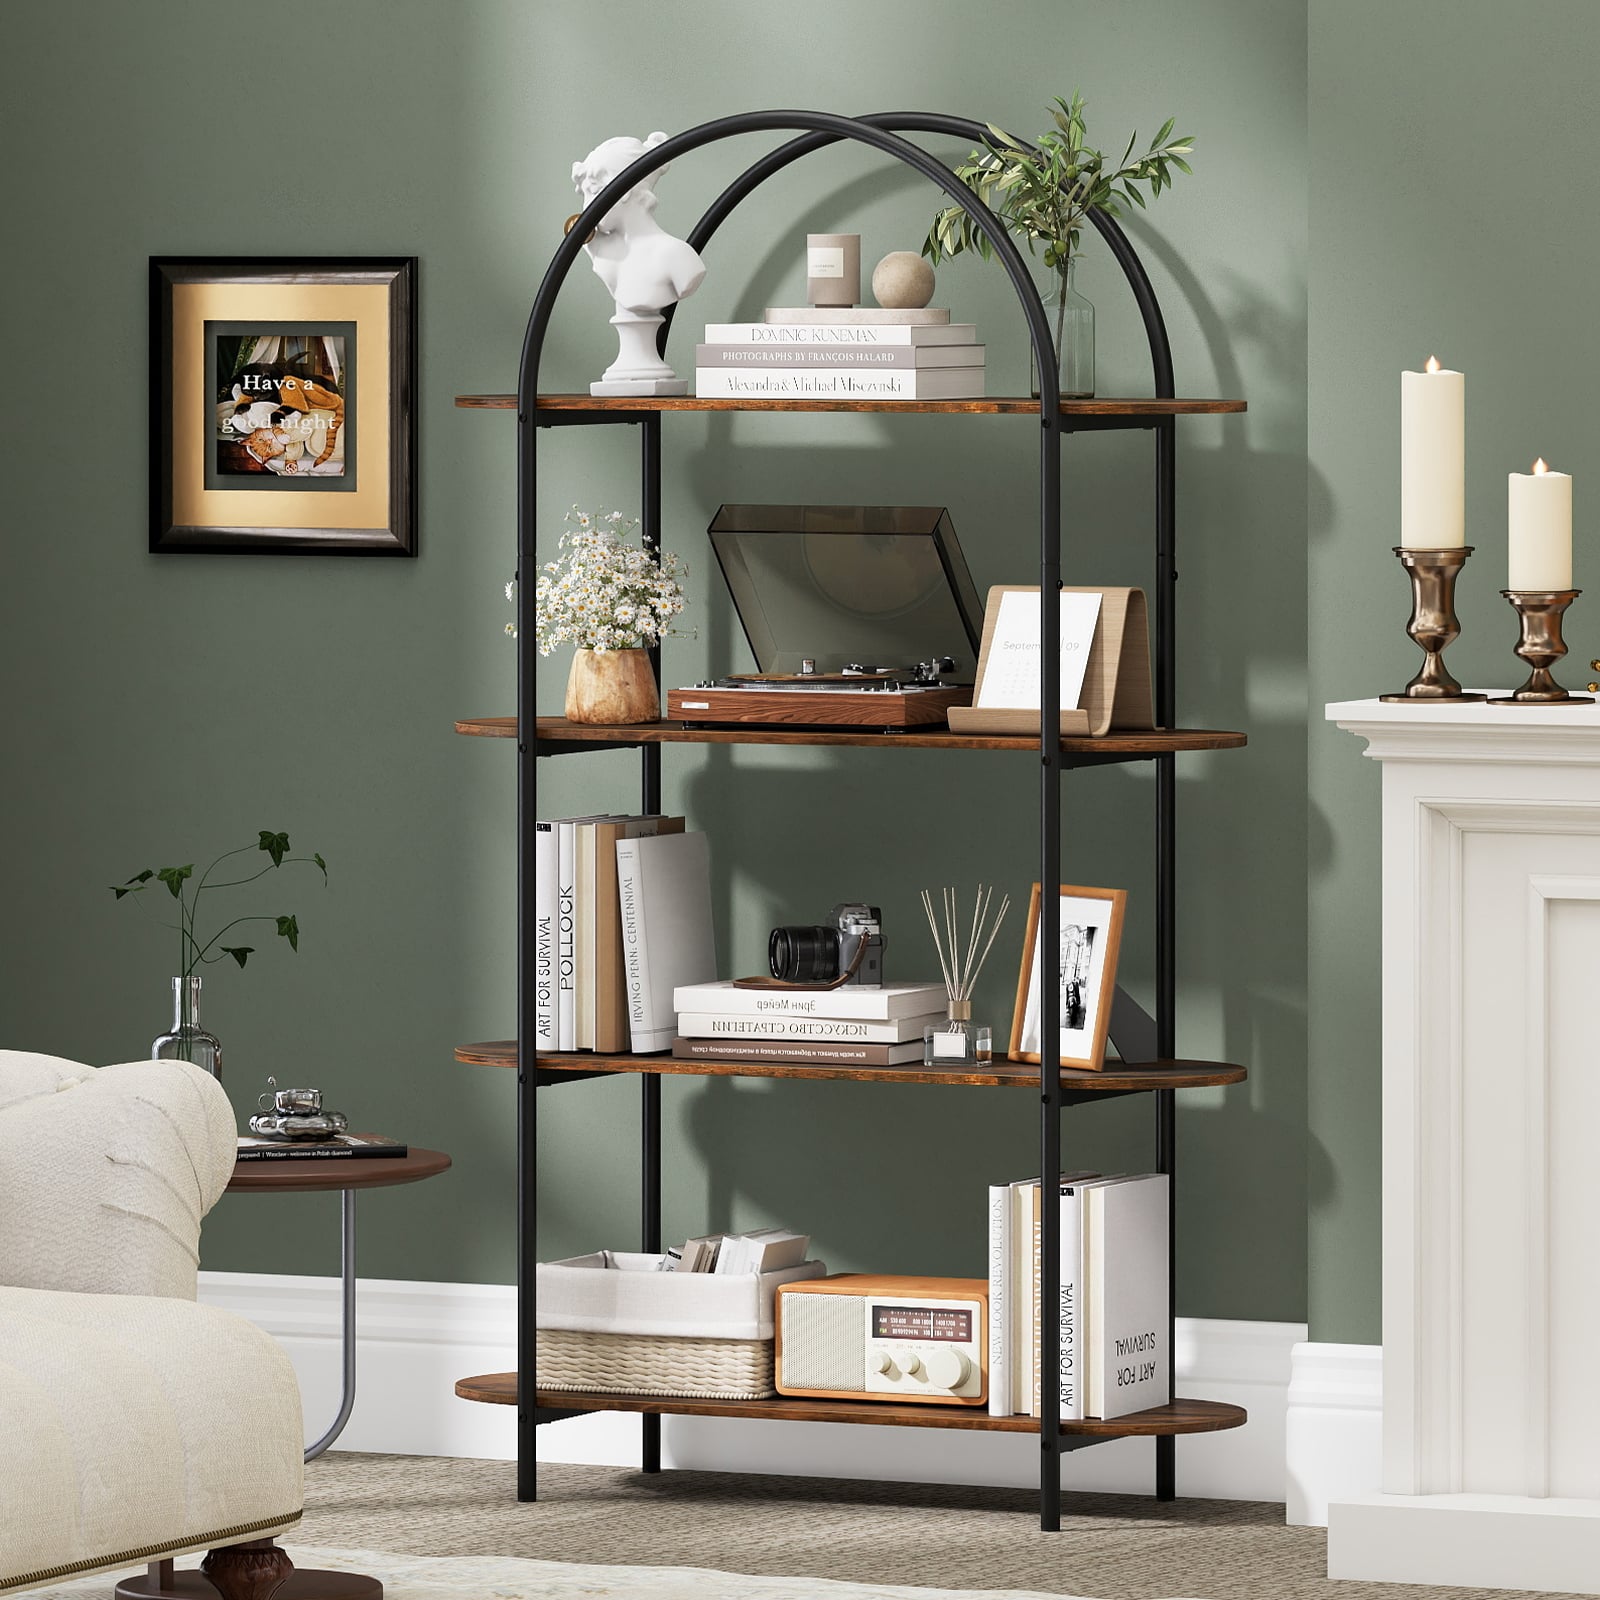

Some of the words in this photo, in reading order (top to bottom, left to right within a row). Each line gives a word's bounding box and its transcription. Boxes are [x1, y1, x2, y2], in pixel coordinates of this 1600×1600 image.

[751, 328, 807, 342] DOMINIC
[812, 328, 878, 342] KUNEMAN
[722, 351, 793, 361] PHOTOGRAPHS
[795, 352, 806, 361] BY
[808, 352, 854, 363] FRANÇOIS
[856, 352, 895, 362] HALARD
[242, 374, 296, 391] Have
[303, 379, 315, 390] a
[727, 376, 780, 391] Alexandra
[793, 376, 837, 392] Michael
[840, 376, 902, 393] Misczynski
[221, 413, 273, 434] good
[279, 413, 336, 434] night
[1003, 640, 1041, 652] Septem
[1065, 641, 1080, 652] 09
[623, 876, 638, 944] CENTENNIAL
[538, 916, 551, 977] SURVIVAL
[559, 885, 574, 990] POLLOCK
[628, 947, 640, 979] PENN:
[538, 981, 551, 1007] FOR
[631, 981, 643, 1023] IRVING
[538, 1012, 551, 1038] ART
[992, 1199, 1003, 1288] REVOLUTION
[992, 1291, 1003, 1329] LOOK
[1060, 1282, 1073, 1344] SURVIVAL
[992, 1335, 1003, 1365] NEW
[1115, 1332, 1156, 1357] SURVIVAL
[1060, 1348, 1073, 1376] FOR
[1138, 1360, 1156, 1382] ART
[1117, 1365, 1136, 1387] FOR
[1060, 1379, 1073, 1407] ART
